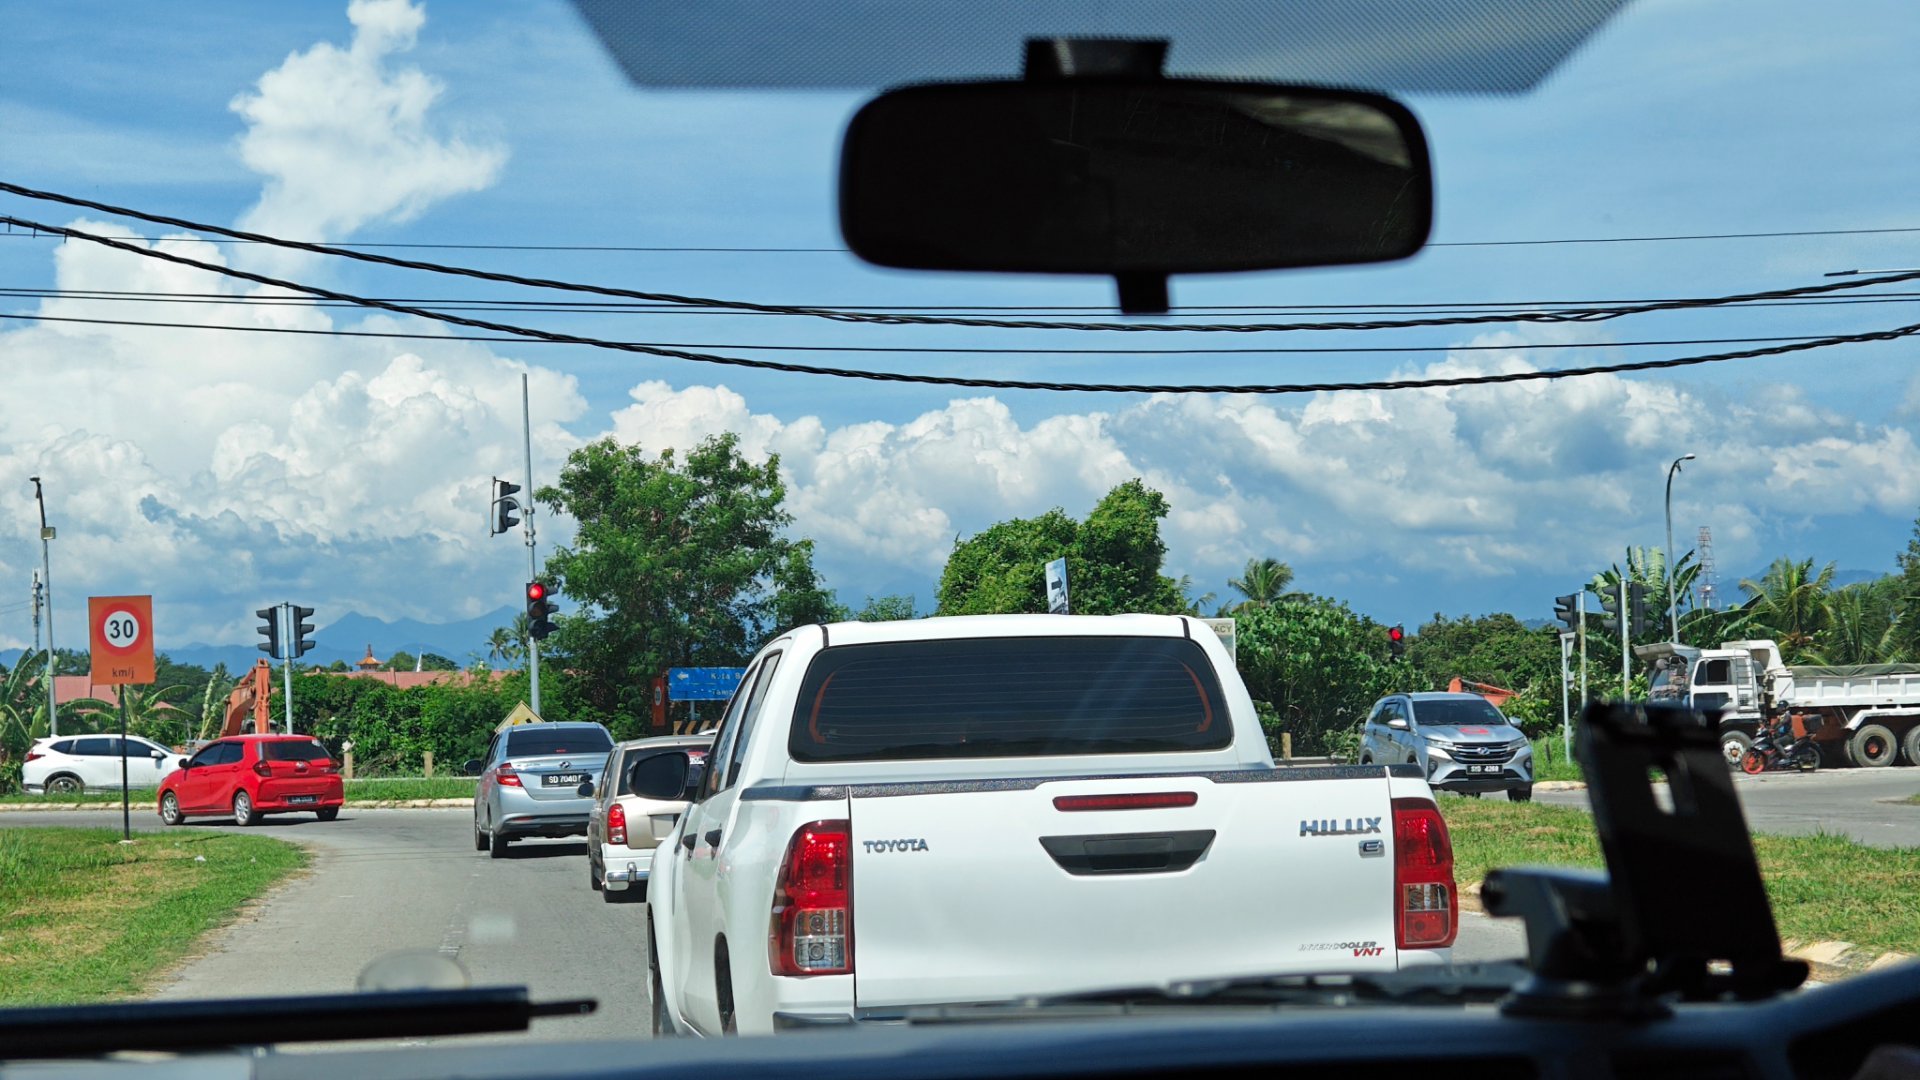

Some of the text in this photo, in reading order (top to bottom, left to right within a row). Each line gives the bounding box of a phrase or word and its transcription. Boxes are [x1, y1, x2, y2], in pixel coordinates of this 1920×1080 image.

[109, 619, 134, 639] 30
[1210, 625, 1232, 633] ACY
[112, 666, 135, 679] km/j
[548, 775, 559, 784] SD
[1299, 817, 1382, 837] HILUX
[862, 838, 930, 854] TOYOTA
[1298, 941, 1377, 952] INTERCOOLER
[1353, 947, 1385, 957] VNT
